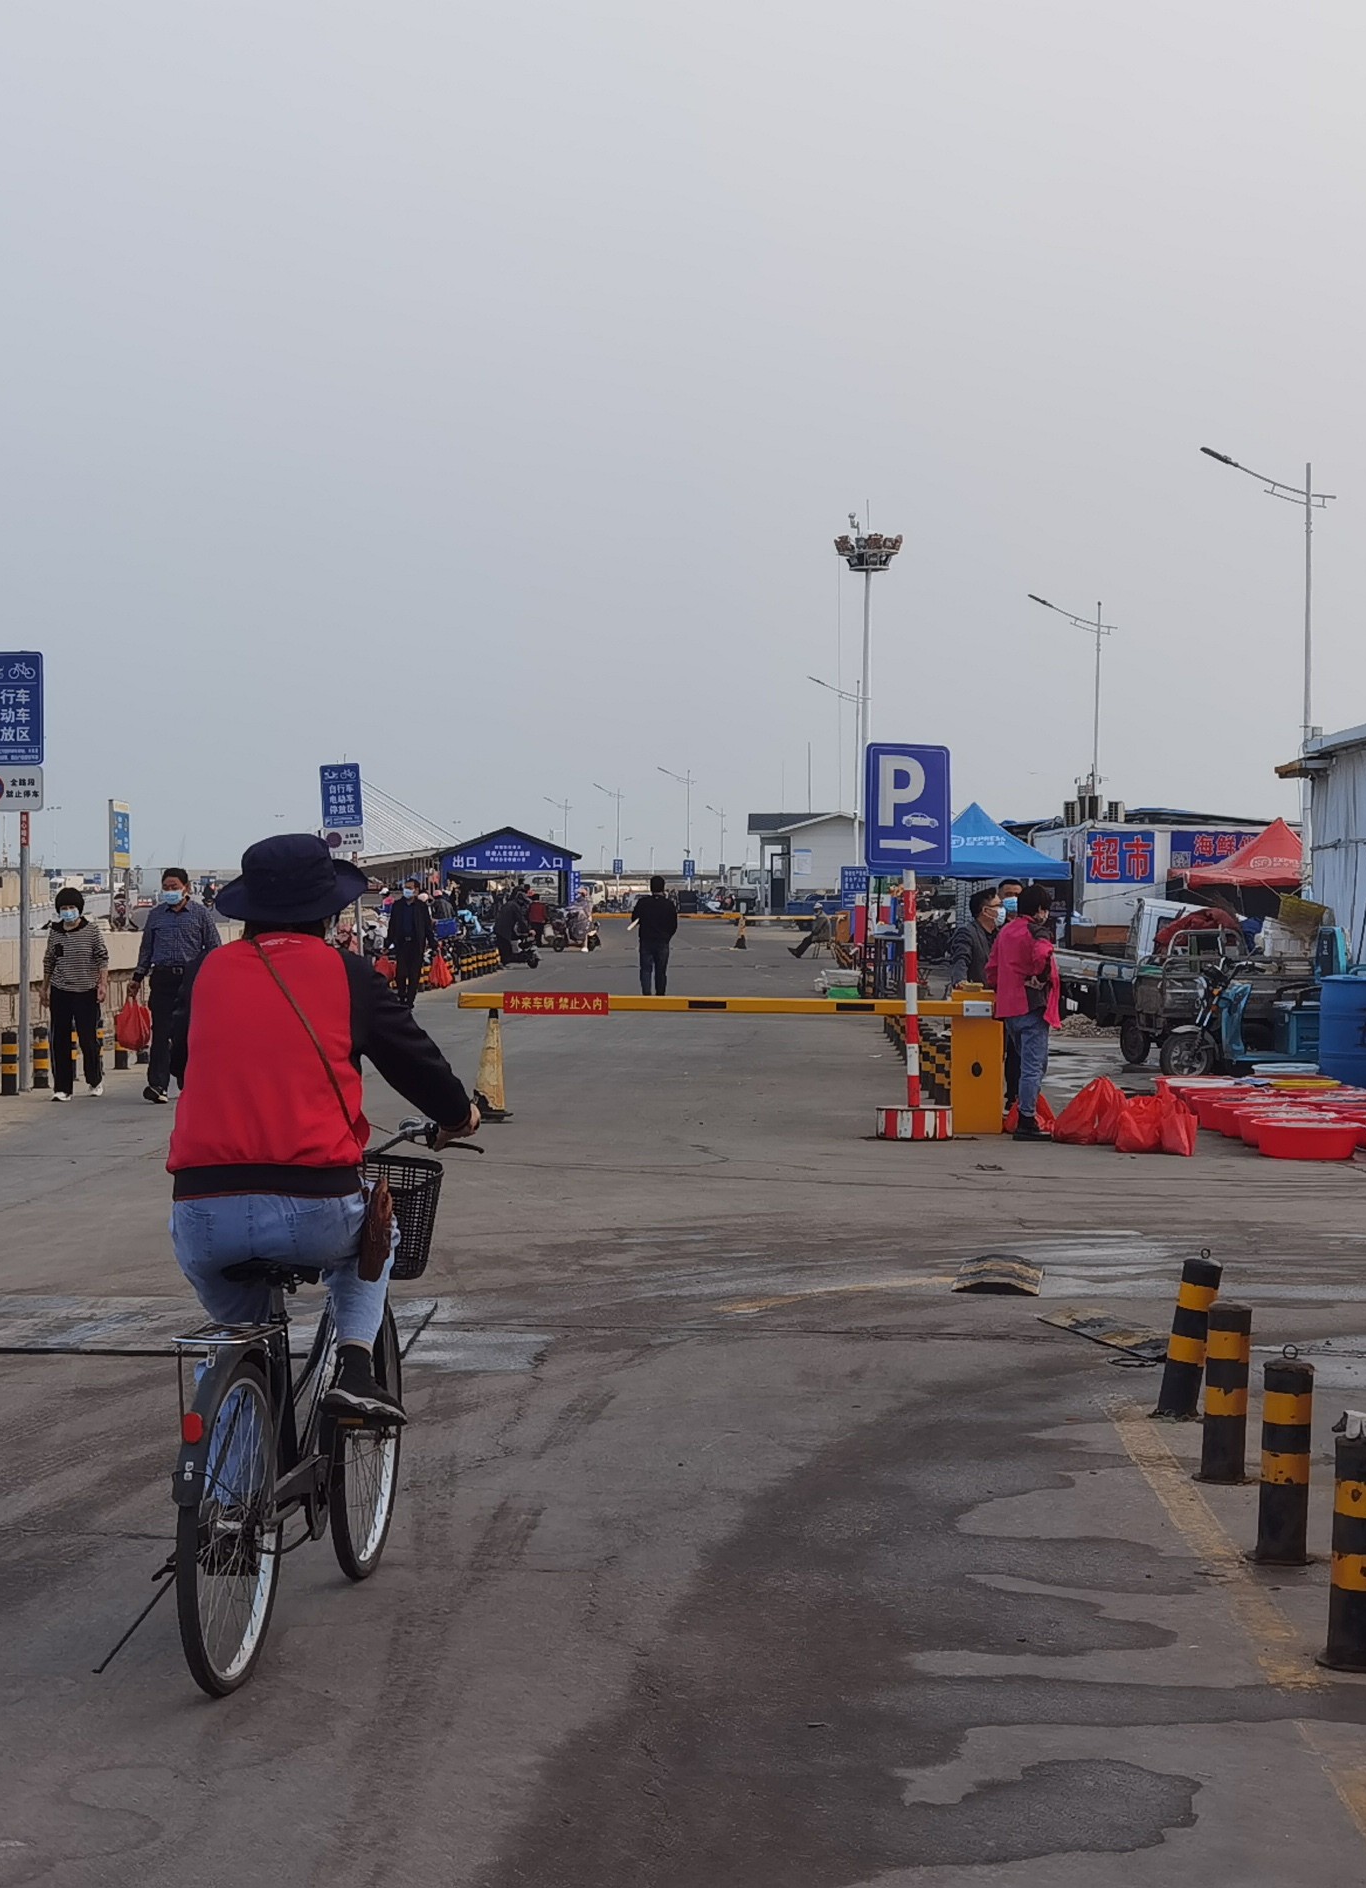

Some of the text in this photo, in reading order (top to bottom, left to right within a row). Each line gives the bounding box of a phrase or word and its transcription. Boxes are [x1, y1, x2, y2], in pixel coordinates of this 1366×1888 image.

[5, 790, 39, 798] 禁止停车
[329, 784, 354, 794] 自行车
[878, 754, 926, 827] P
[329, 795, 355, 804] 电动车
[330, 805, 355, 815] 停放区
[452, 855, 477, 868] 出口
[538, 856, 563, 868] 入口
[1090, 835, 1152, 879] 超市
[510, 996, 602, 1010] 外来车辆 禁止入内
